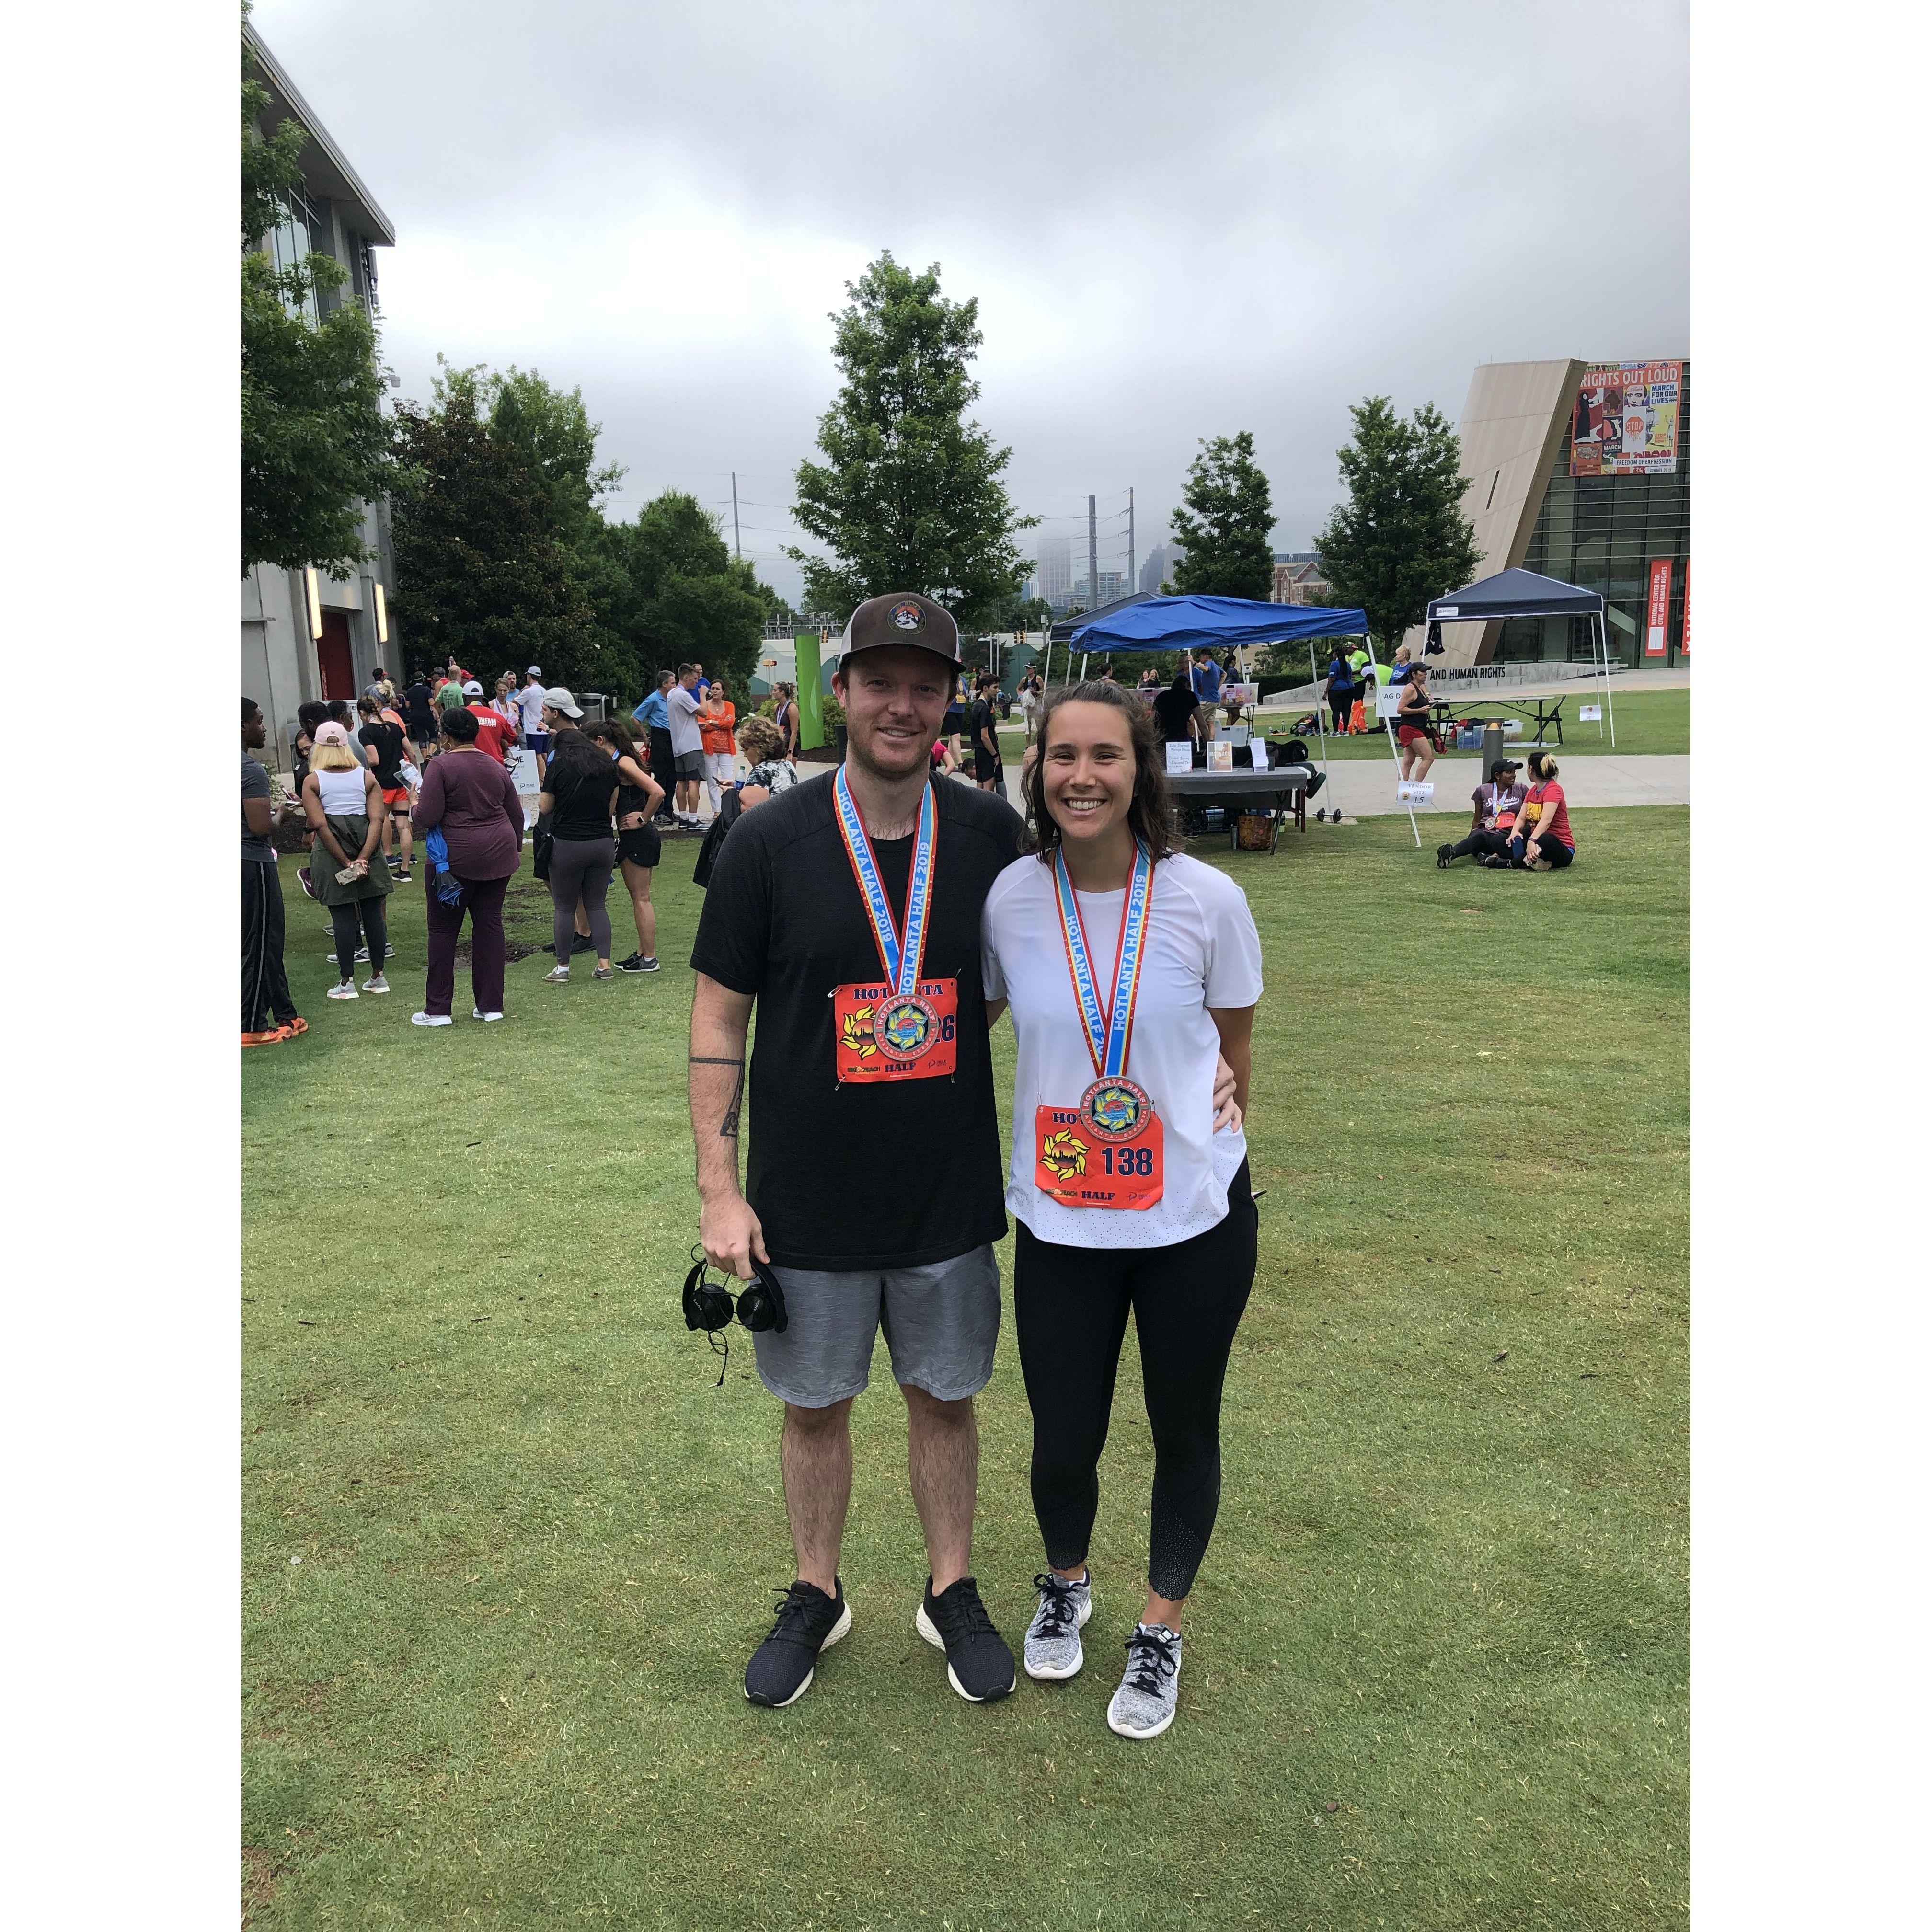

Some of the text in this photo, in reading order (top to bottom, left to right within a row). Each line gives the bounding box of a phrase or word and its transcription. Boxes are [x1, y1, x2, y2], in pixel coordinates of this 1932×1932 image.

[1580, 368, 1677, 387] RIGHTS OUT LOUD
[1626, 421, 1643, 431] STOP
[1430, 667, 1506, 680] AND HUMAN RIGHTS
[839, 791, 893, 942] HOTLANTA HALF 2019
[901, 842, 929, 995] HOTLANTA HALF 2019
[1114, 874, 1146, 1031] HOTLANTA HALF 2019
[1067, 915, 1091, 993] HOTLANTA
[1083, 995, 1102, 1034] HALF
[853, 984, 943, 1000] HOTTA
[877, 996, 935, 1025] HOTLANTA HALF
[885, 1062, 916, 1073] HALF
[1083, 1079, 1146, 1107] HOTLANTA HALF
[1052, 1112, 1084, 1125] HO
[1101, 1147, 1153, 1176] 138
[1081, 1191, 1116, 1200] HALF
